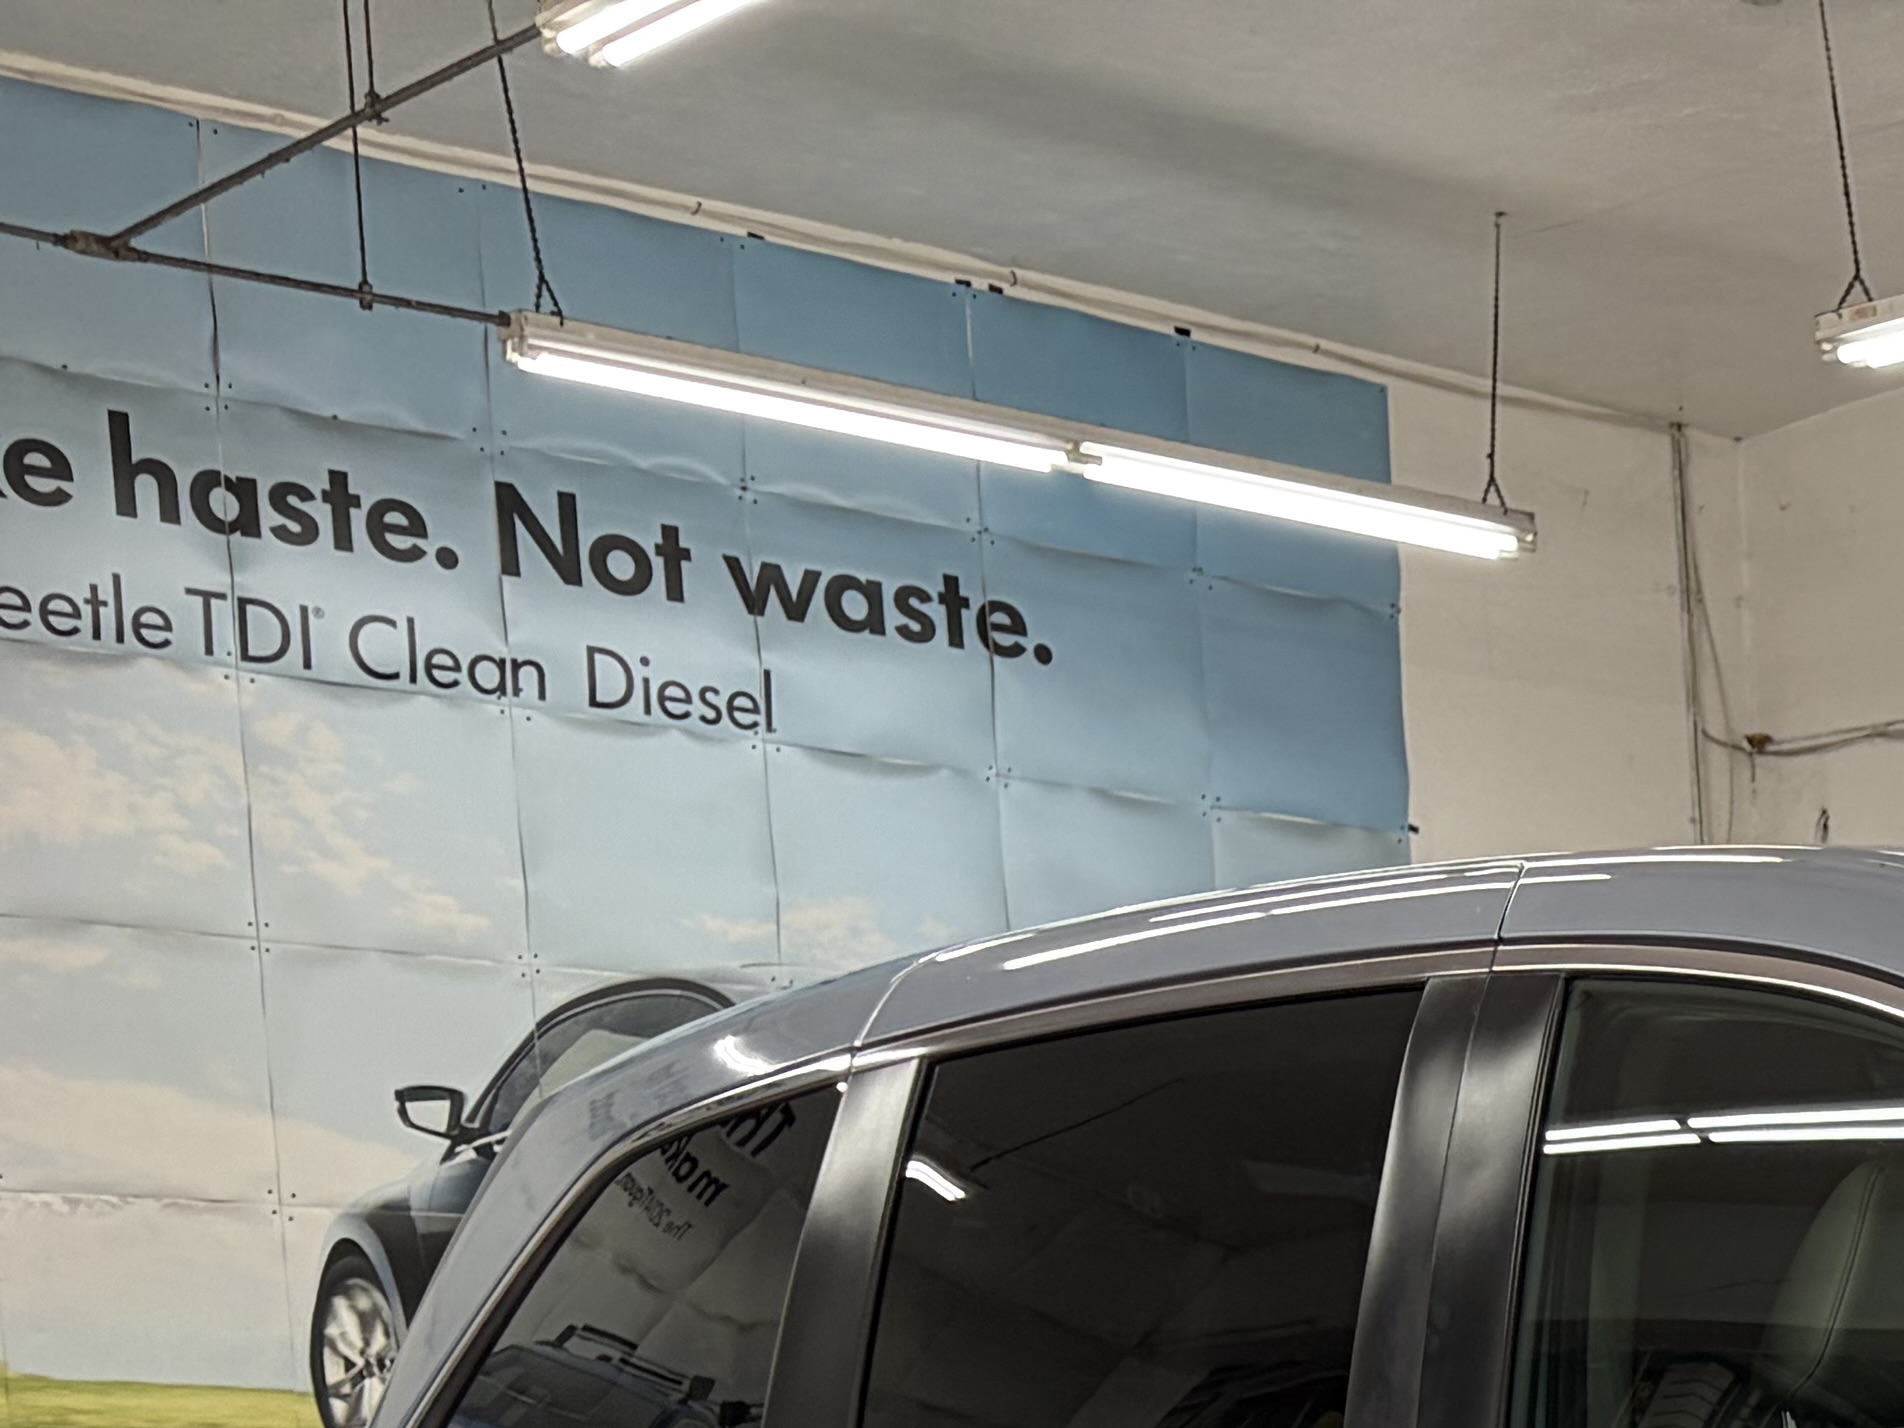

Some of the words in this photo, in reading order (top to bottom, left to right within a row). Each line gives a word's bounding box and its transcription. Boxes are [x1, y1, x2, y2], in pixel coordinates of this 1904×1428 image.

[0, 438, 74, 507] e
[107, 409, 460, 570] haste.
[494, 480, 692, 603] Not
[722, 549, 1054, 665] waste.
[348, 612, 547, 702] Clean
[587, 646, 777, 735] Diesel
